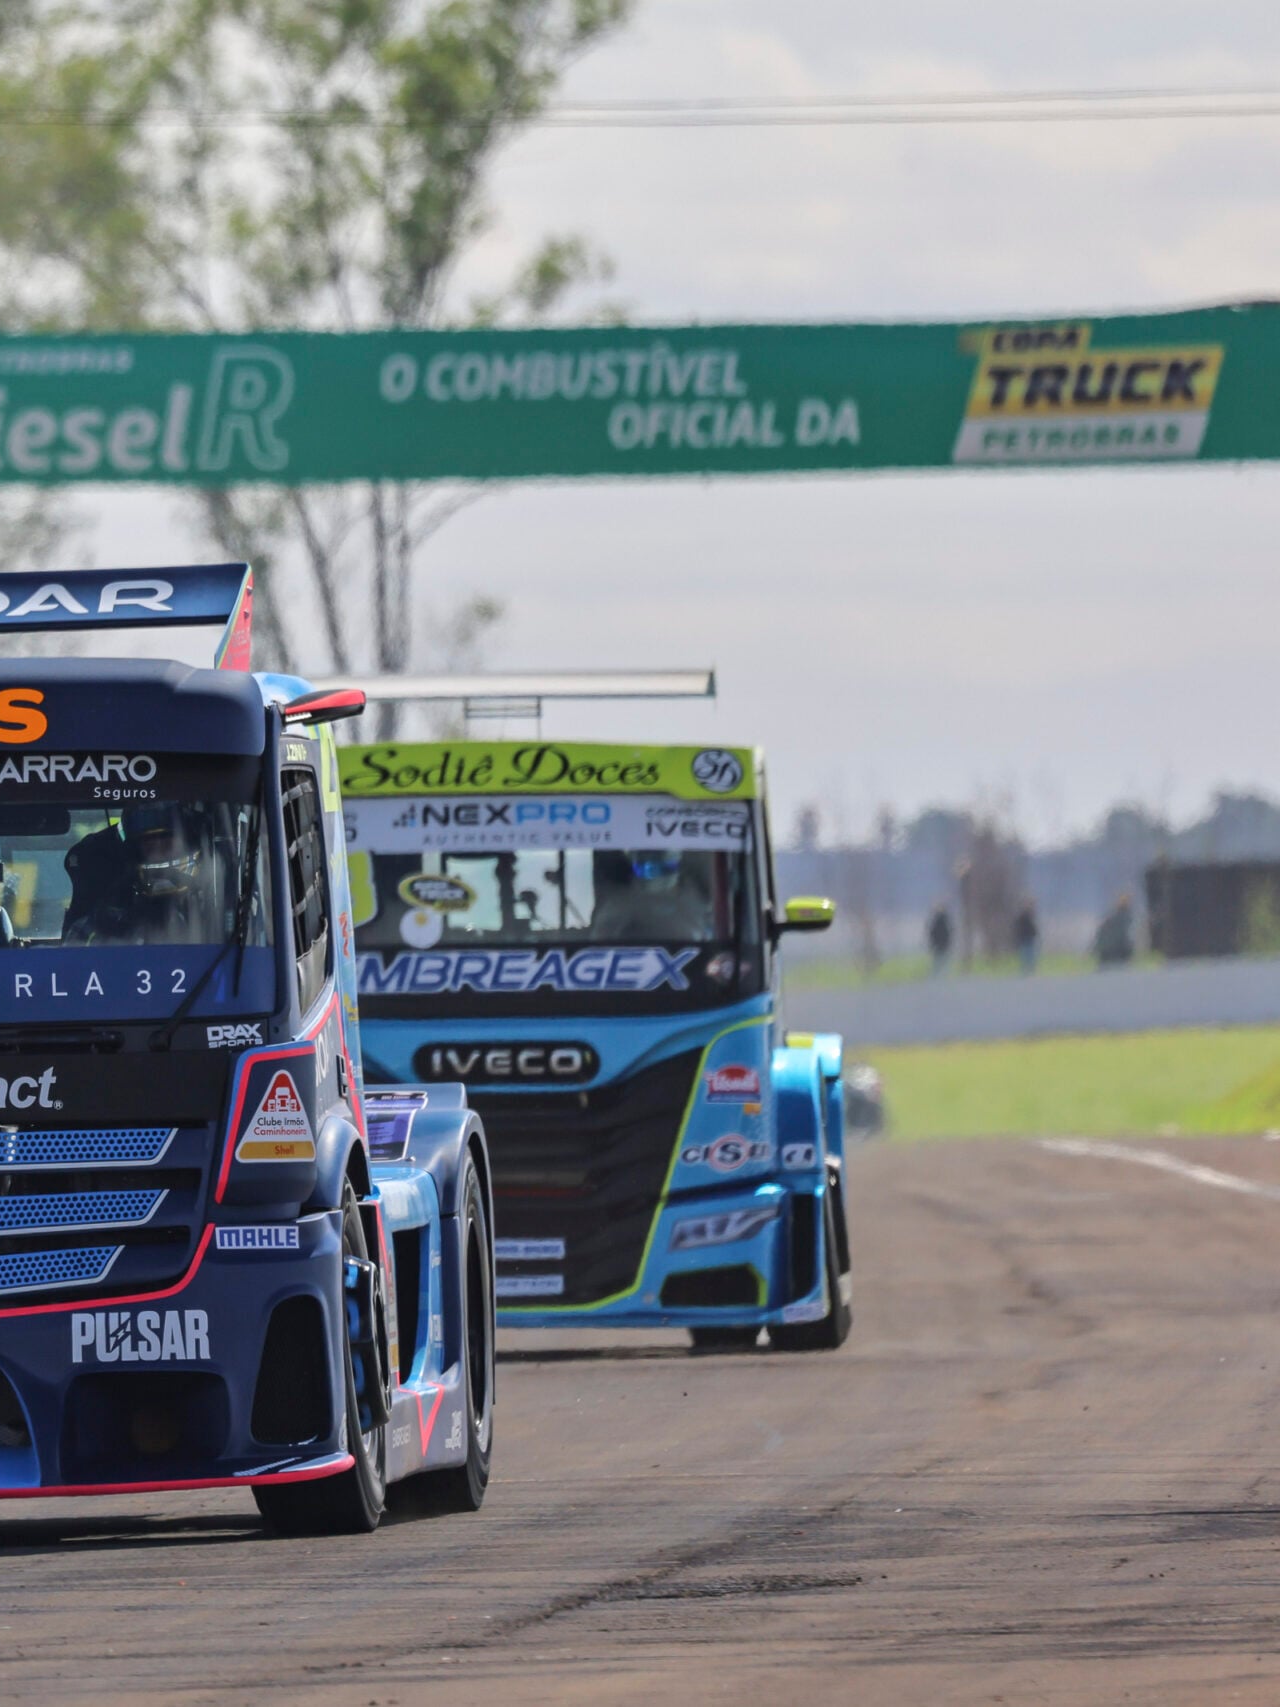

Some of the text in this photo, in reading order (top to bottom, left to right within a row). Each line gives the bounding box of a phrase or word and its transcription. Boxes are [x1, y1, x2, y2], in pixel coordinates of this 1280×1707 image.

[378, 340, 748, 402] O COMBUSTÍVEL
[985, 357, 1208, 410] TRUCK
[607, 397, 861, 449] OFICIAL DA
[981, 423, 1182, 449] PETROBRAS
[502, 744, 660, 788] Doces
[92, 786, 157, 801] Seguros
[422, 802, 612, 827] NEXPRO
[423, 830, 613, 846] AUTHENTIC VALUE
[646, 820, 748, 840] IVECO
[136, 968, 187, 995] 32
[357, 948, 699, 993] MBREAGEX
[206, 1023, 262, 1042] DRAX
[208, 1038, 263, 1049] SPORTS
[431, 1048, 583, 1074] IVECO
[253, 1127, 308, 1137] Caminhoneiro
[256, 1117, 305, 1127] Clube Irmão
[275, 1145, 296, 1155] Shell
[219, 1227, 298, 1248] MAHLE
[70, 1309, 211, 1363] PULSAR
